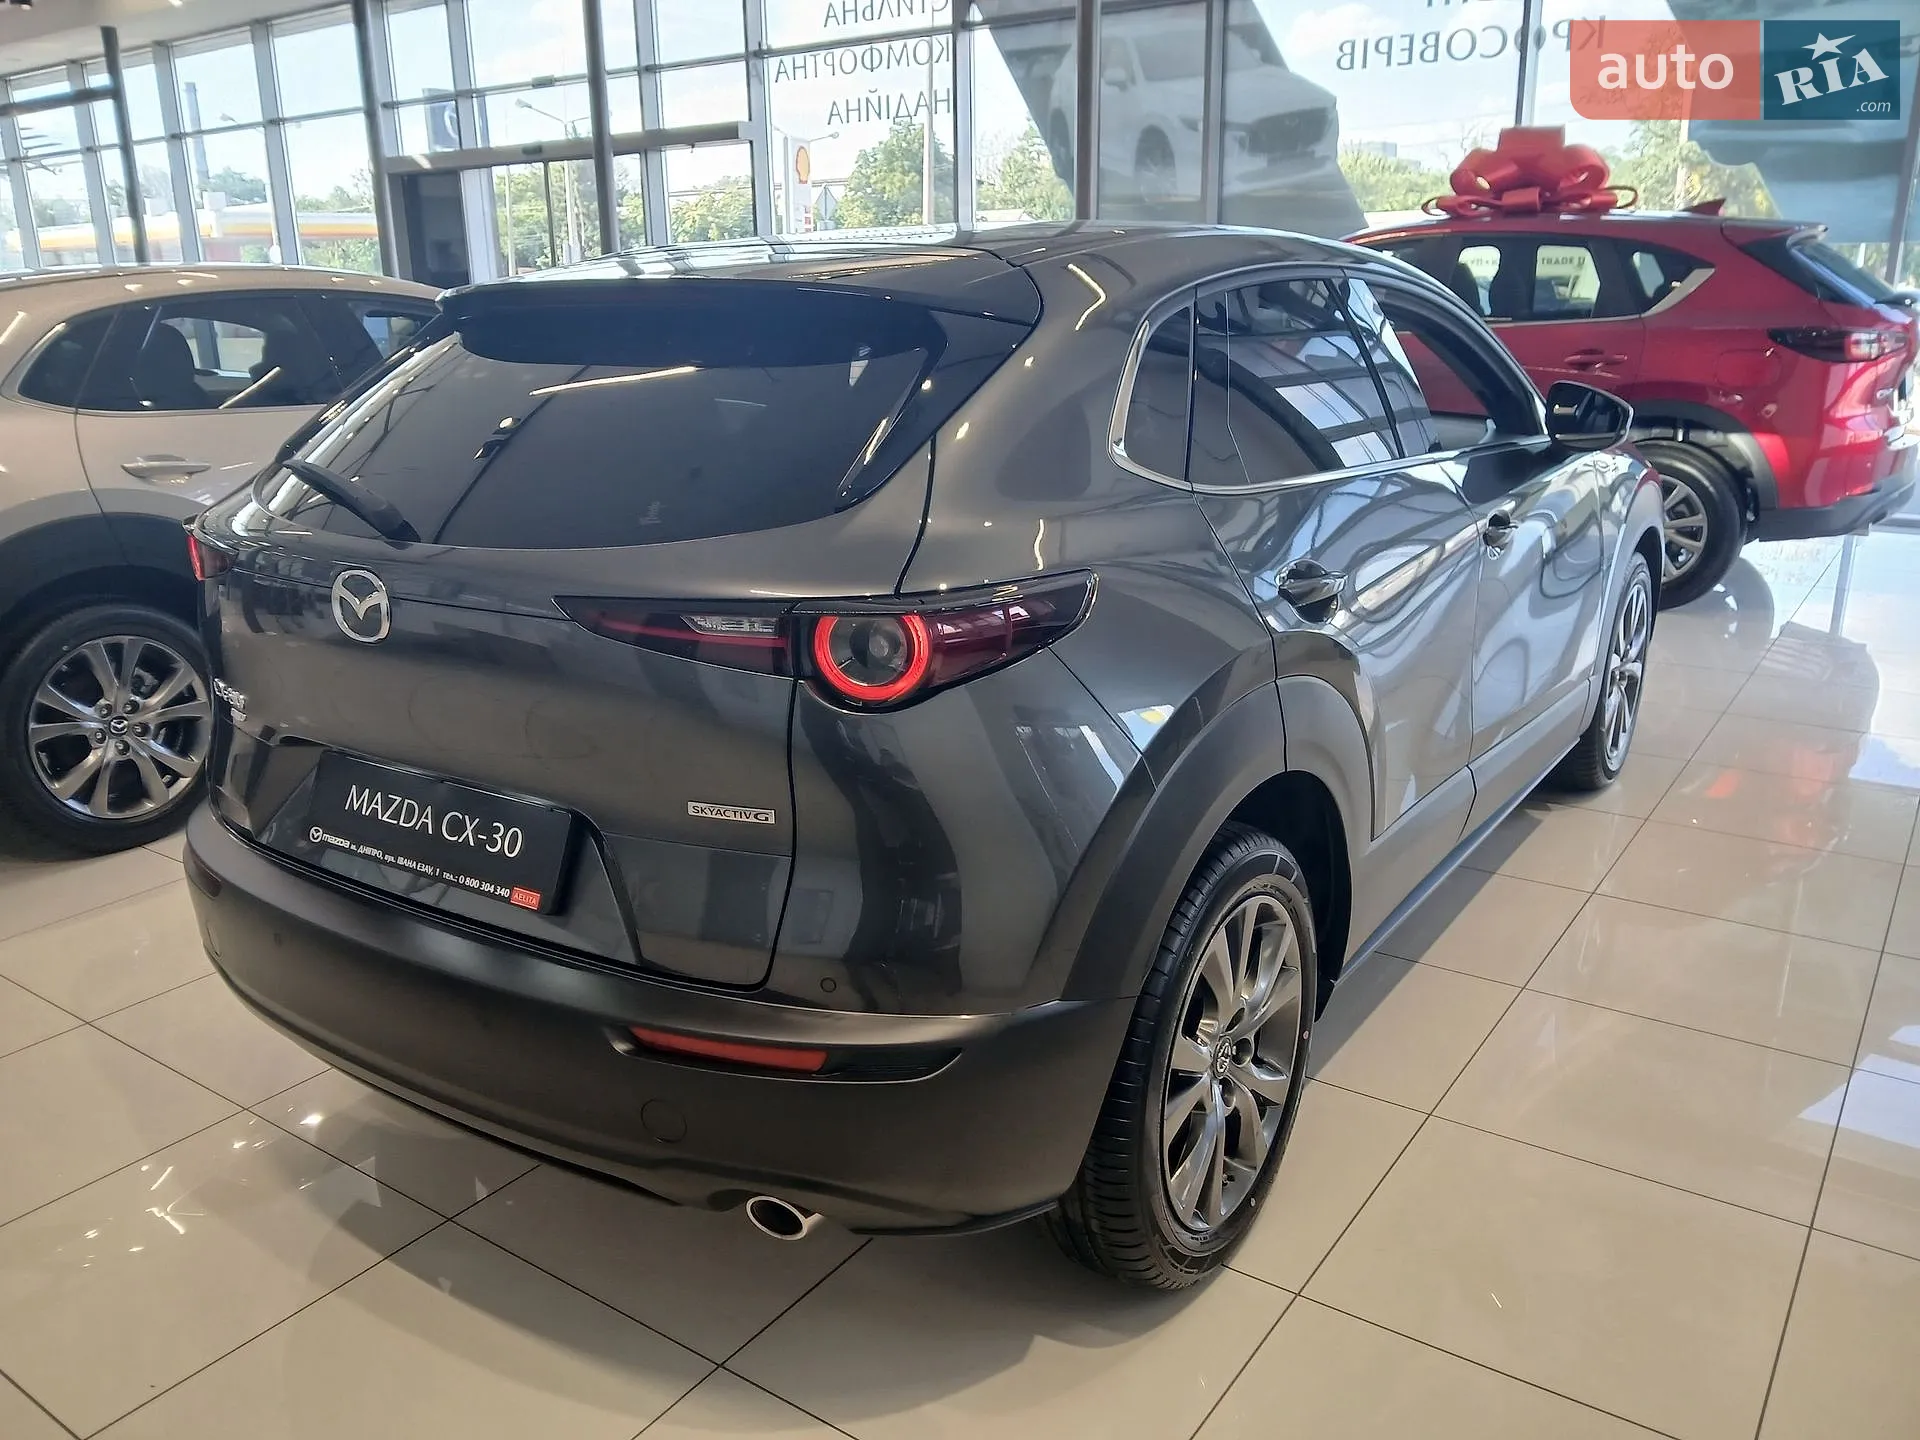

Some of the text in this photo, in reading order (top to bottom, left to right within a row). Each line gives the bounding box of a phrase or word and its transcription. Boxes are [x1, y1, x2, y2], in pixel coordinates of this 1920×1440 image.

[344, 784, 523, 858] MAZDA CX-30
[322, 833, 350, 849] mazda
[458, 875, 465, 884] 0
[465, 878, 480, 889] 800
[480, 882, 495, 894] 304
[495, 886, 511, 898] 340
